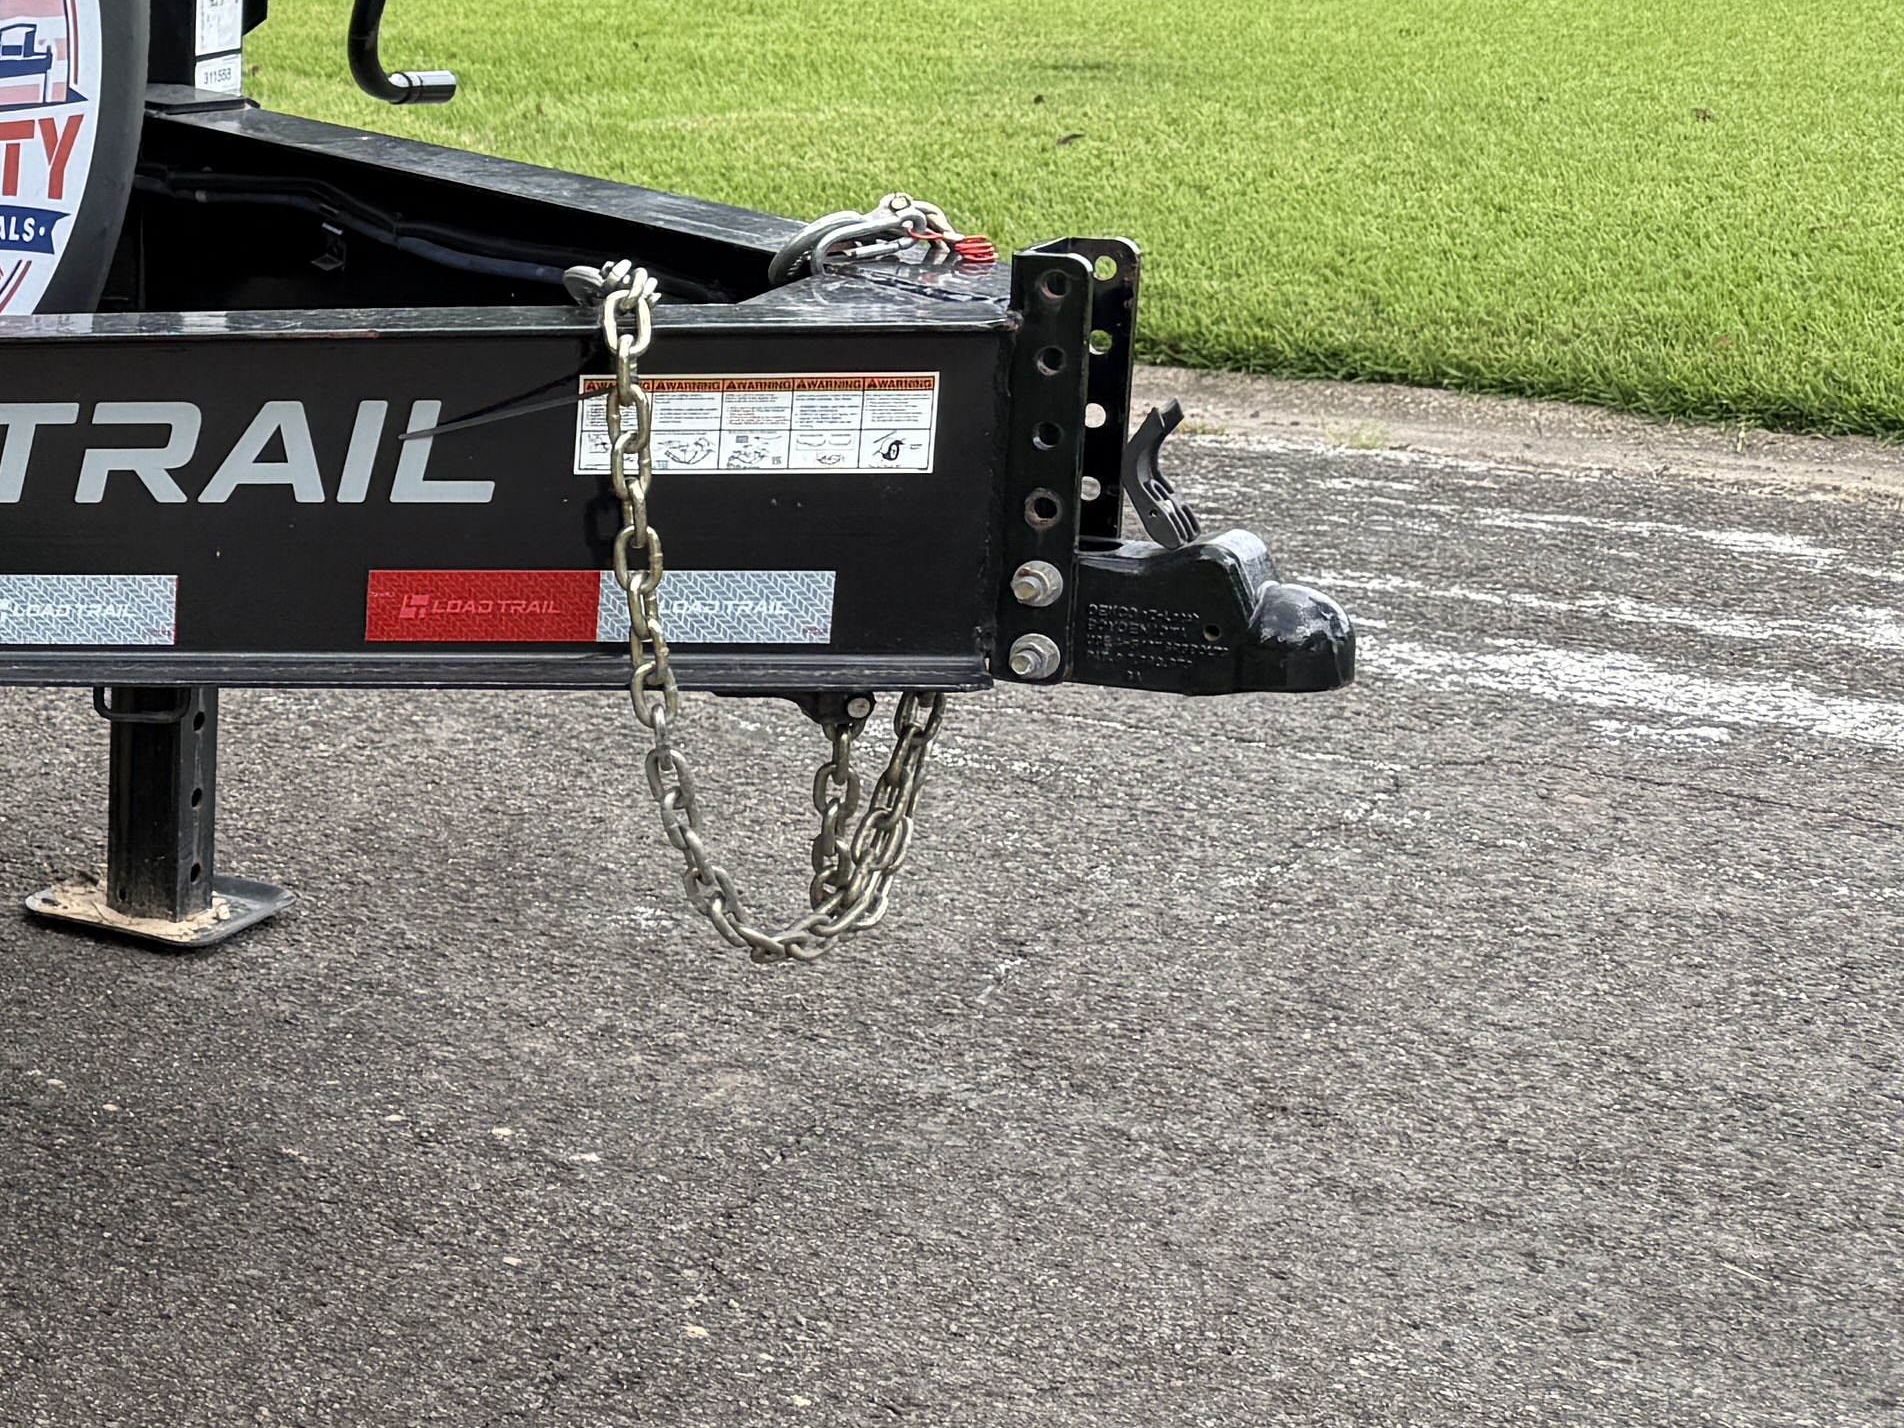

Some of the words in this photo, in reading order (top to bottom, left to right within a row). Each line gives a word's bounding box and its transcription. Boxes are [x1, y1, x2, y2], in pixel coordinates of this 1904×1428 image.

[665, 381, 721, 391] WARNING
[734, 380, 791, 391] WARNING
[808, 379, 862, 390] WARNING
[877, 378, 933, 389] WARNING
[431, 599, 493, 614] LOAD
[495, 599, 560, 614] TRAIL
[721, 598, 789, 614] TRAIL
